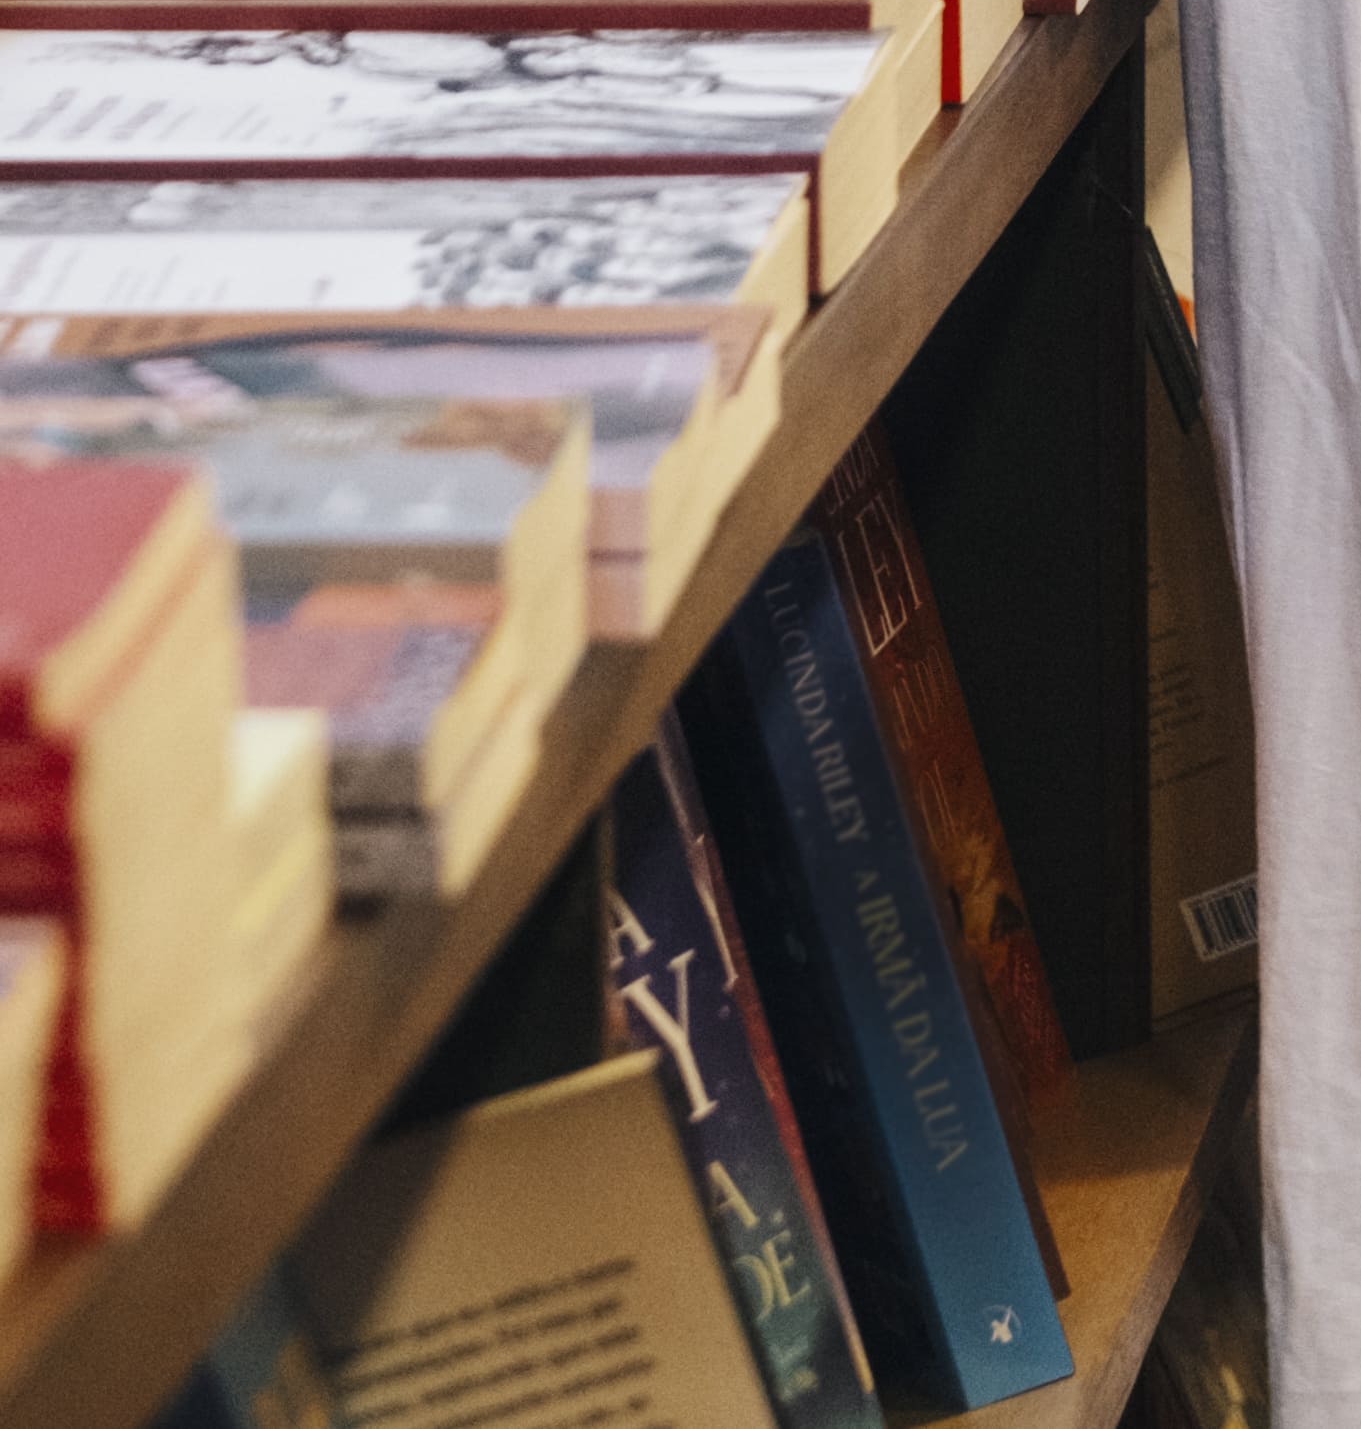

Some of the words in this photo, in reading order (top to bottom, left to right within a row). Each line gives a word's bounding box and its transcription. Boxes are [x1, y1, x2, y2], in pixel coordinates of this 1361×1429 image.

[764, 579, 833, 745] LUCINDA
[812, 740, 869, 844] RILEY
[854, 866, 880, 895] A
[855, 892, 927, 1014] IRMÃ
[620, 948, 719, 1123] Y
[892, 1010, 942, 1073] DA
[911, 1077, 969, 1174] LUA
[709, 1159, 760, 1229] A
